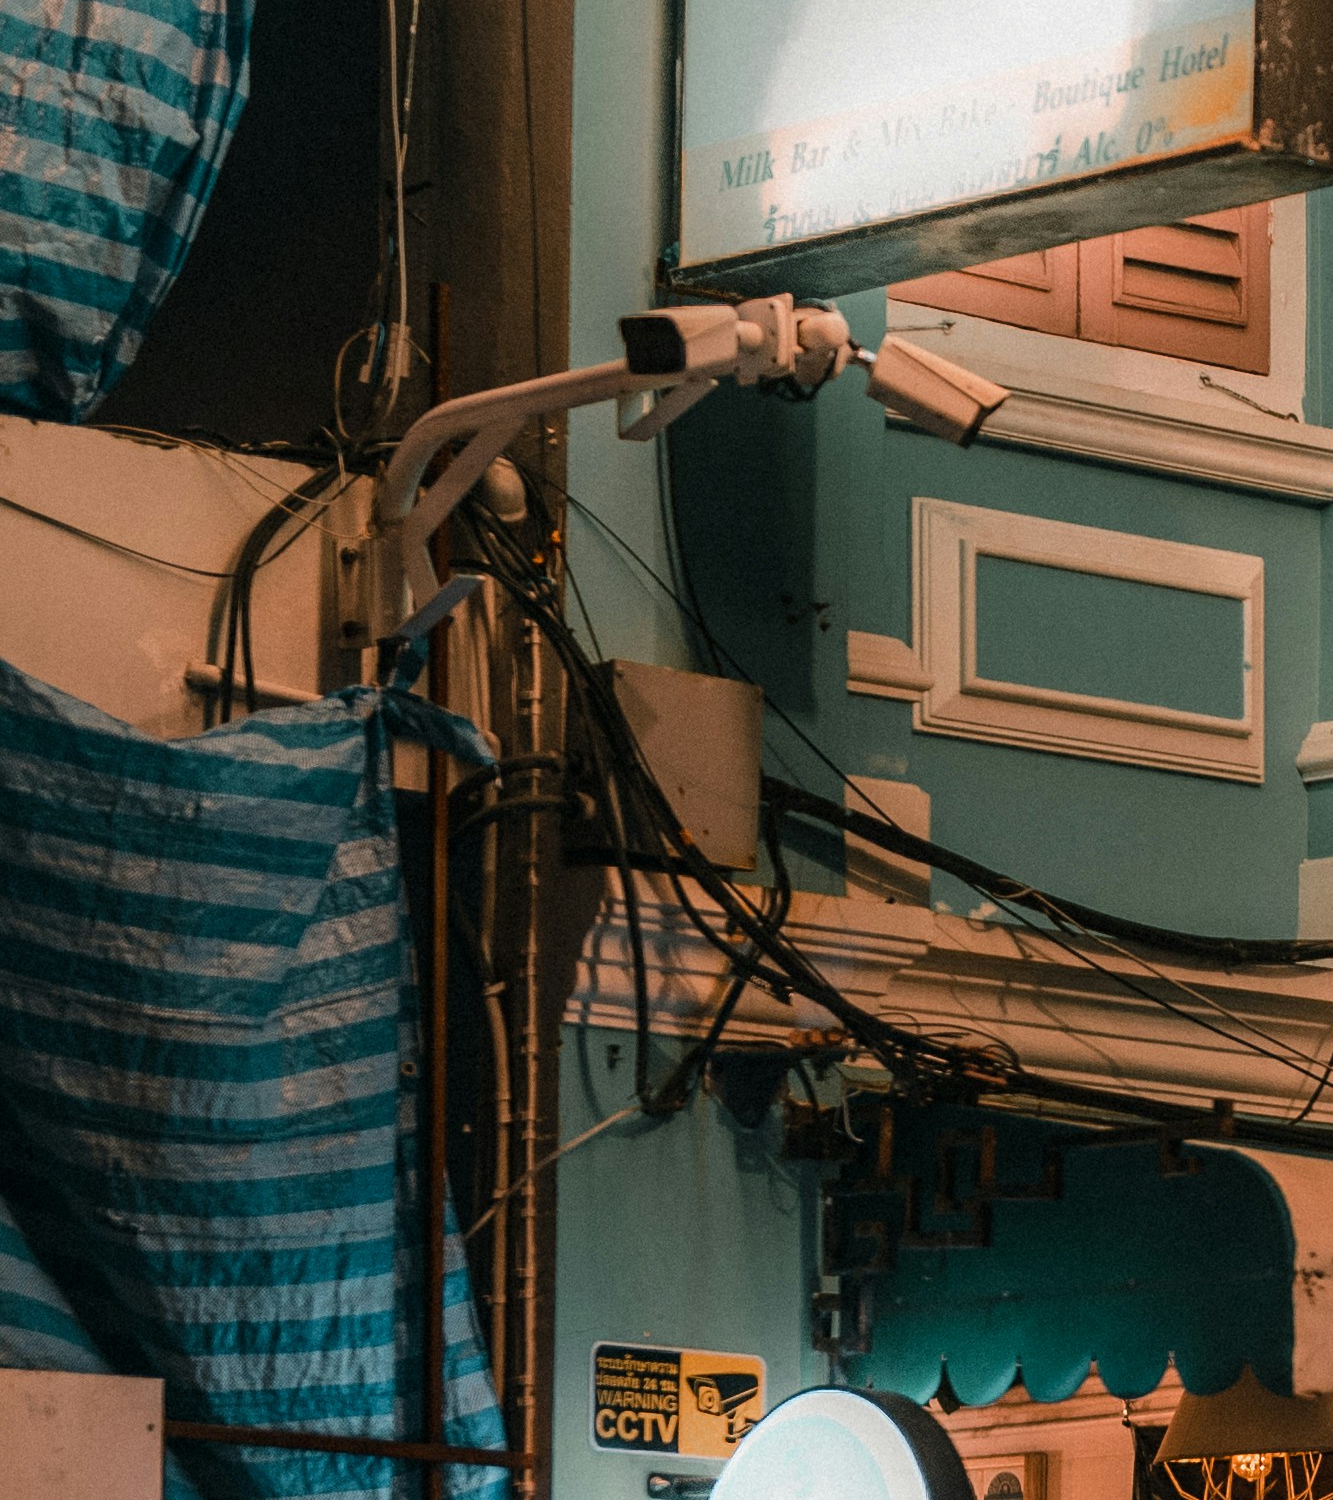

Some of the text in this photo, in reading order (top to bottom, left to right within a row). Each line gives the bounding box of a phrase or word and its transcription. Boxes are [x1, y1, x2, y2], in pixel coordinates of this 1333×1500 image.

[717, 150, 777, 194] Milk
[789, 140, 832, 177] Bar
[1032, 63, 1146, 115] Boutique
[1159, 33, 1230, 84] Hotel
[597, 1389, 678, 1412] WARNING
[595, 1408, 679, 1444] CCTV
